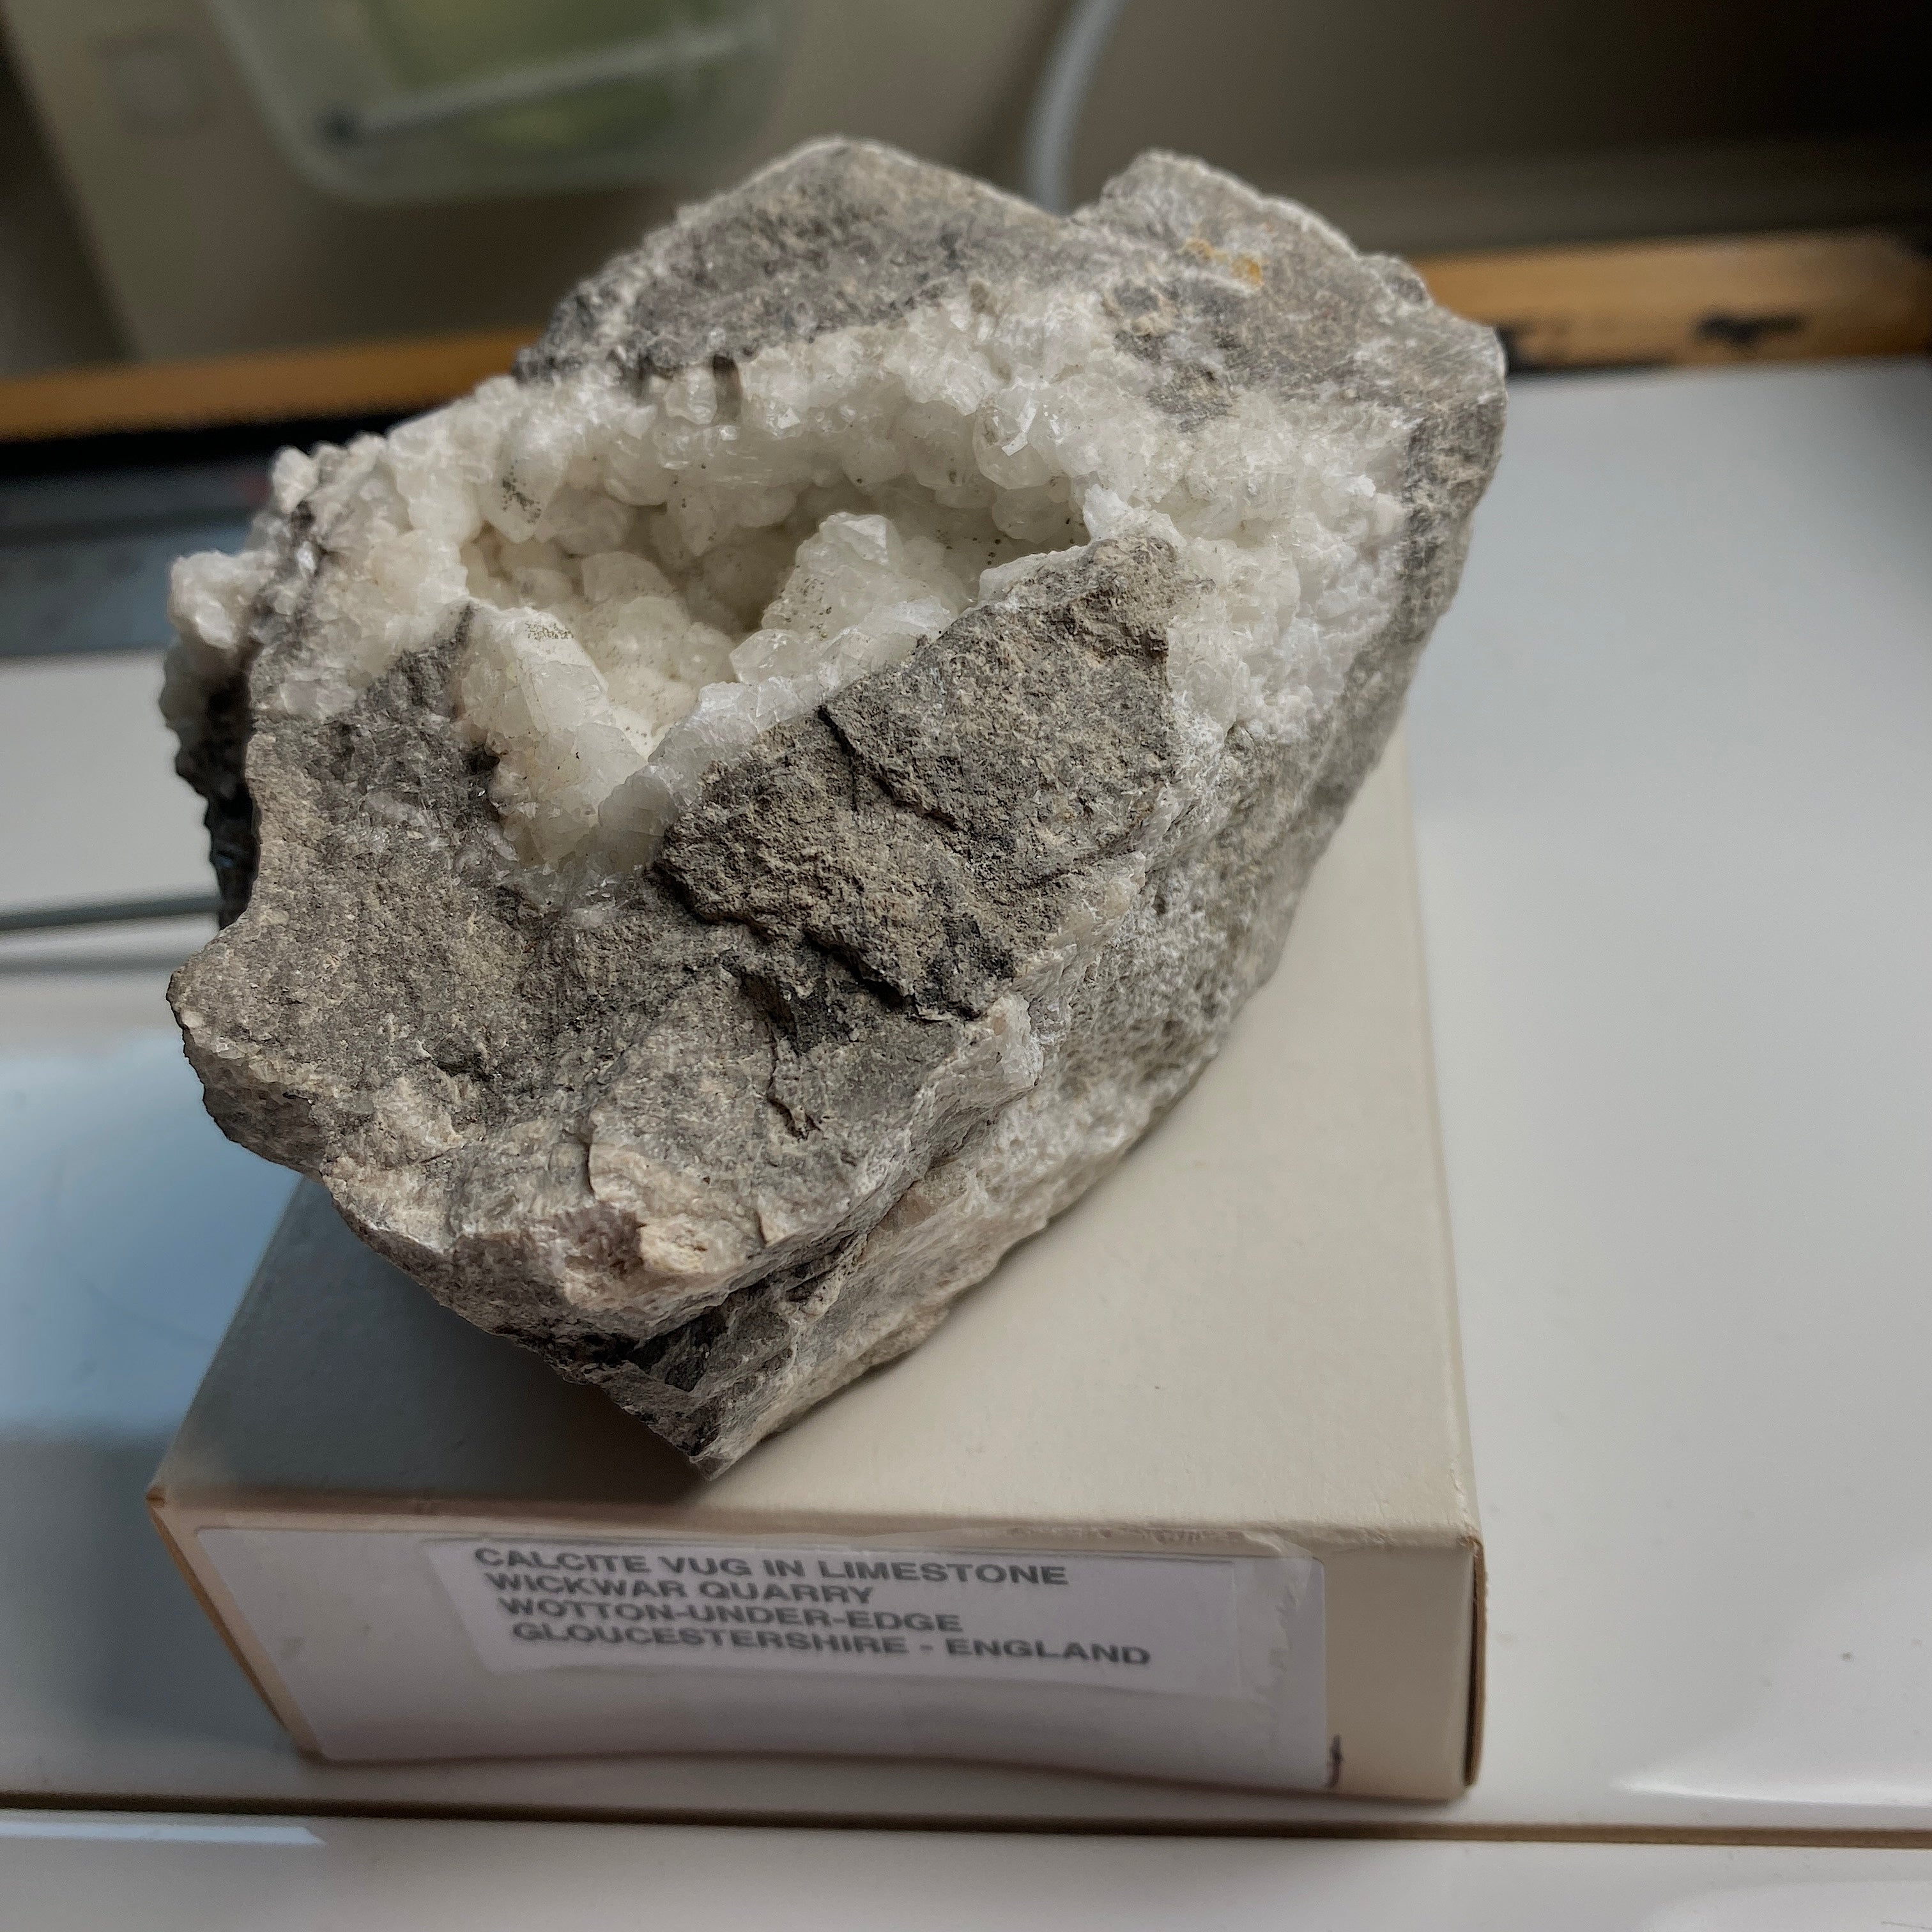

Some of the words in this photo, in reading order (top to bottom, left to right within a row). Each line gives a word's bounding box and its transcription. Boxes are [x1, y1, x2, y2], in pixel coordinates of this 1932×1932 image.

[474, 1547, 650, 1574] CALCITE
[658, 1556, 753, 1577] VUG
[763, 1559, 805, 1577] IN
[818, 1560, 1068, 1586] LIMESTONE
[484, 1572, 687, 1597] WICKWAR
[698, 1580, 874, 1605] QUARRY
[497, 1597, 963, 1632] WOTTON-UNDER-EDGE
[512, 1621, 908, 1655] GLOUCESTERSHIRE
[946, 1637, 1151, 1665] ENGLAND
